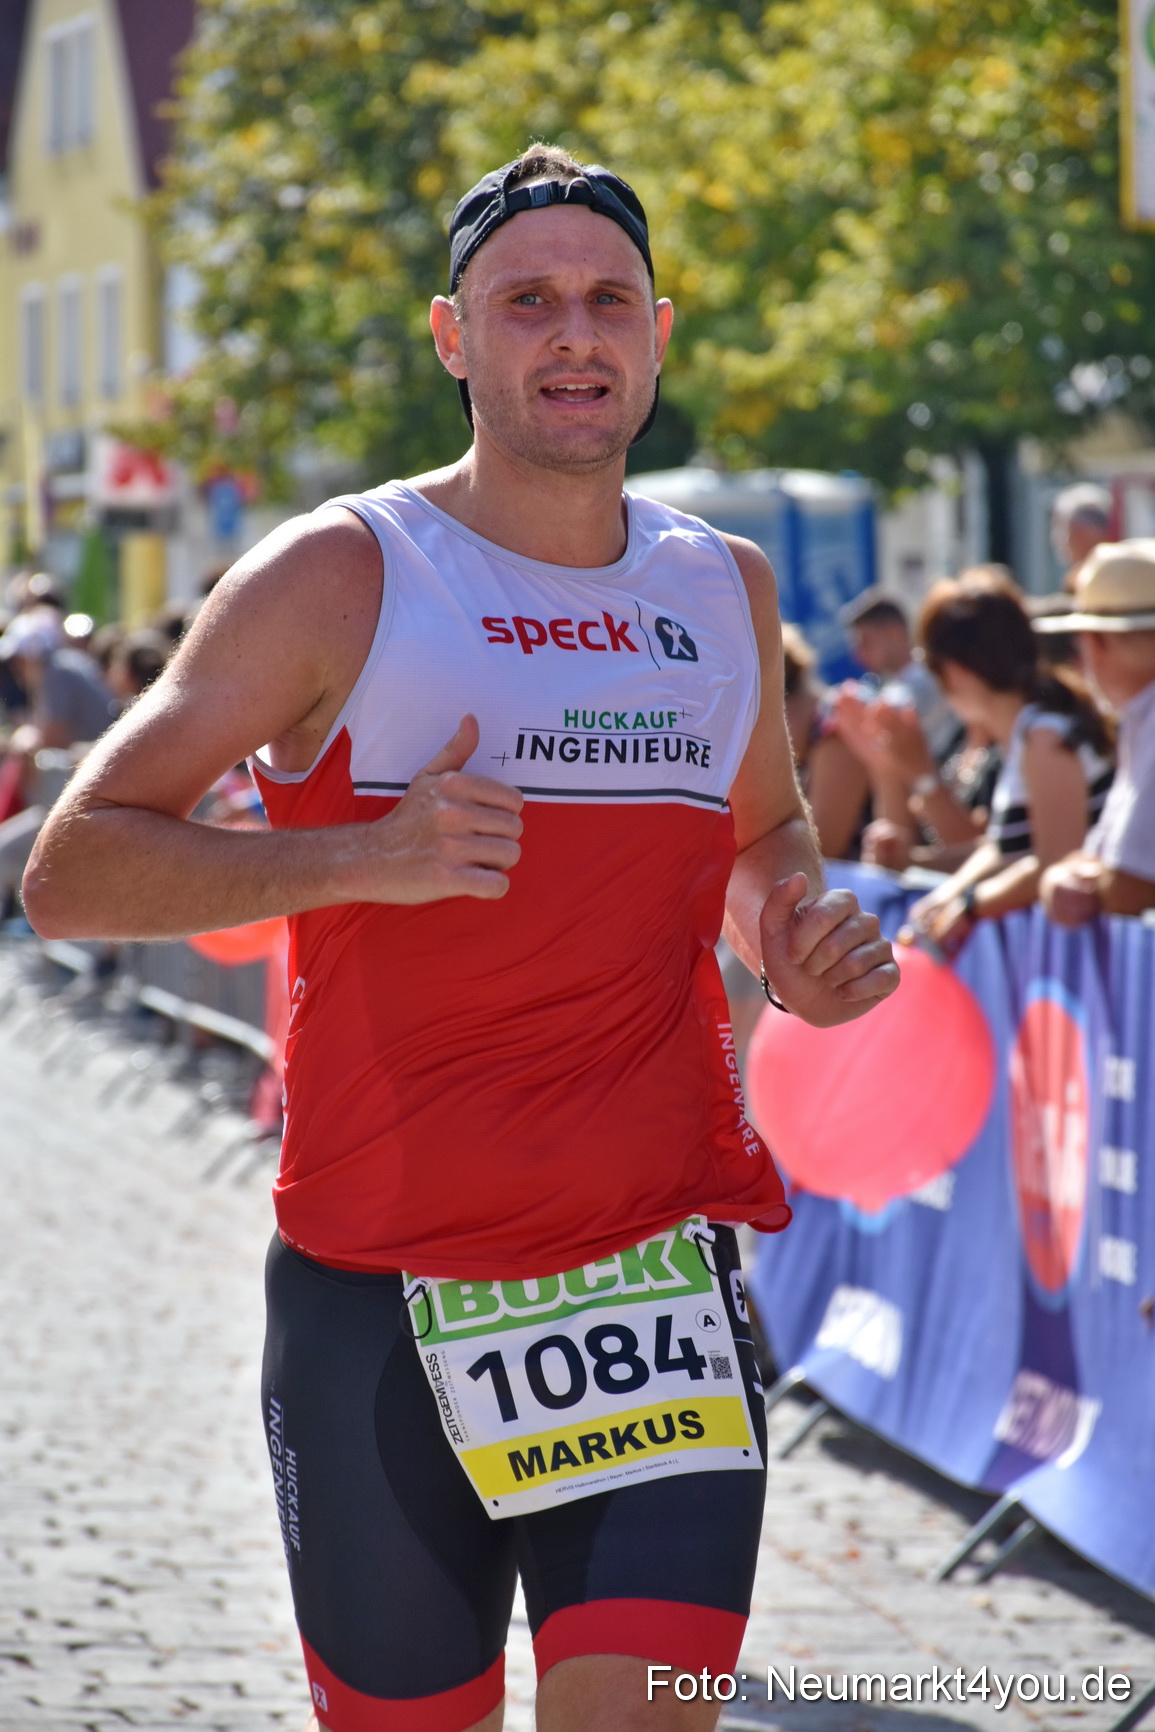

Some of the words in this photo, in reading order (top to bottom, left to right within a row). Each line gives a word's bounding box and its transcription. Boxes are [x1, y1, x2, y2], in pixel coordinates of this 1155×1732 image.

[481, 610, 640, 654] speck
[564, 709, 678, 730] HUCKAUF
[515, 734, 711, 769] INGENIEURE
[704, 1314, 716, 1327] A
[466, 1314, 707, 1423] 1084
[507, 1410, 706, 1482] MARKUS
[285, 1447, 300, 1551] HUCKAUF
